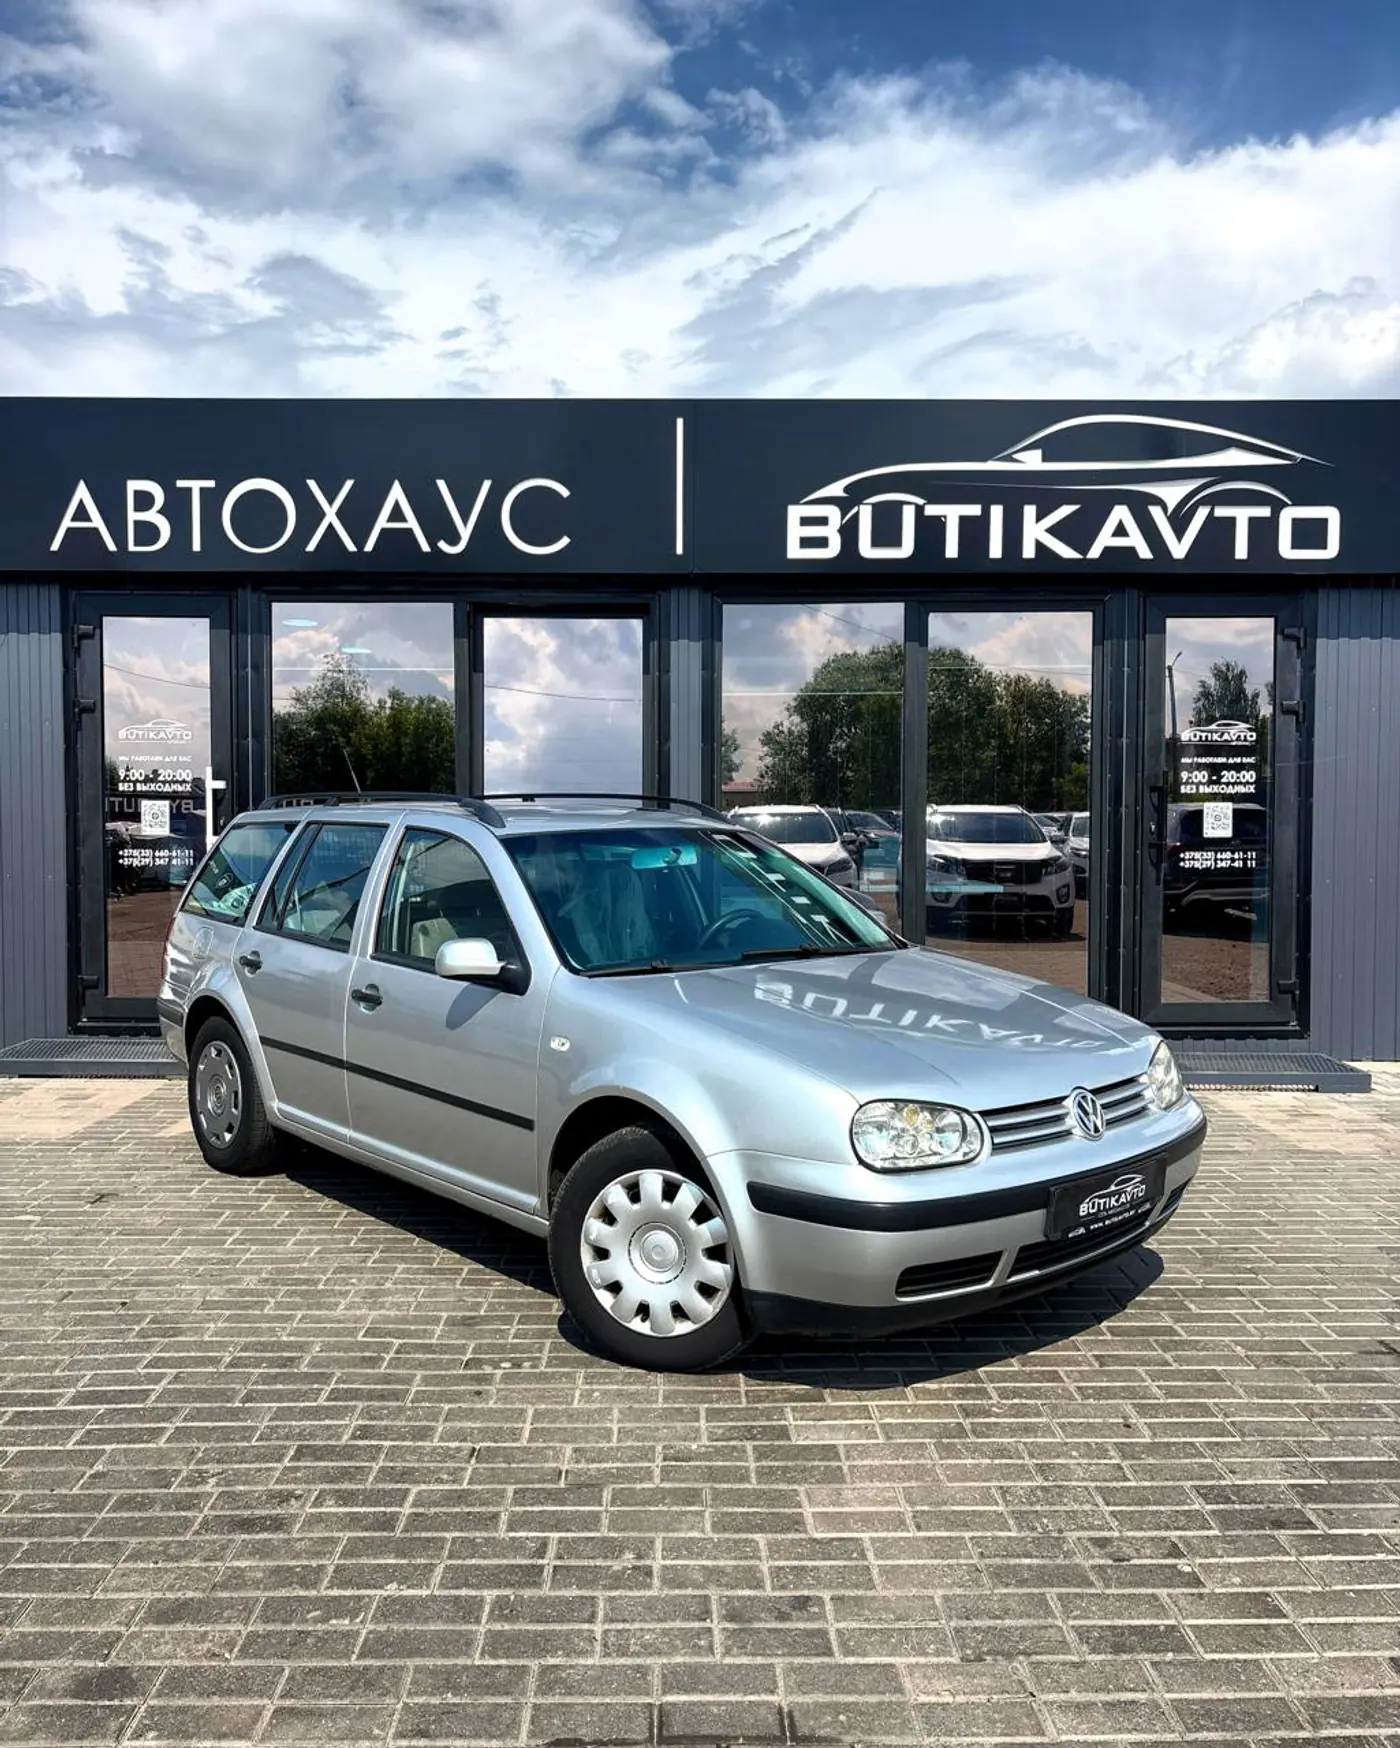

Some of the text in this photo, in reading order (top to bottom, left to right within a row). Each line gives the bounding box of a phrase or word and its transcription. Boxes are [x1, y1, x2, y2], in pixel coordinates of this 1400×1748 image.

[50, 477, 571, 555] АВТОХАУС
[786, 504, 1340, 559] BUTIKAVTO
[118, 730, 192, 740] BUTIKAVTO
[1181, 731, 1256, 742] BUTIKAVTO
[118, 769, 144, 781] 9:00
[158, 769, 192, 781] 20:00
[1180, 771, 1208, 783] 9:00
[1220, 771, 1256, 783] 20:00
[118, 783, 192, 792] БЕЗ ВЫХОДНЫХ
[1180, 784, 1256, 794] БЕЗ ВЫХОДНЫХ
[1079, 1185, 1146, 1217] BUTIKAVTO
